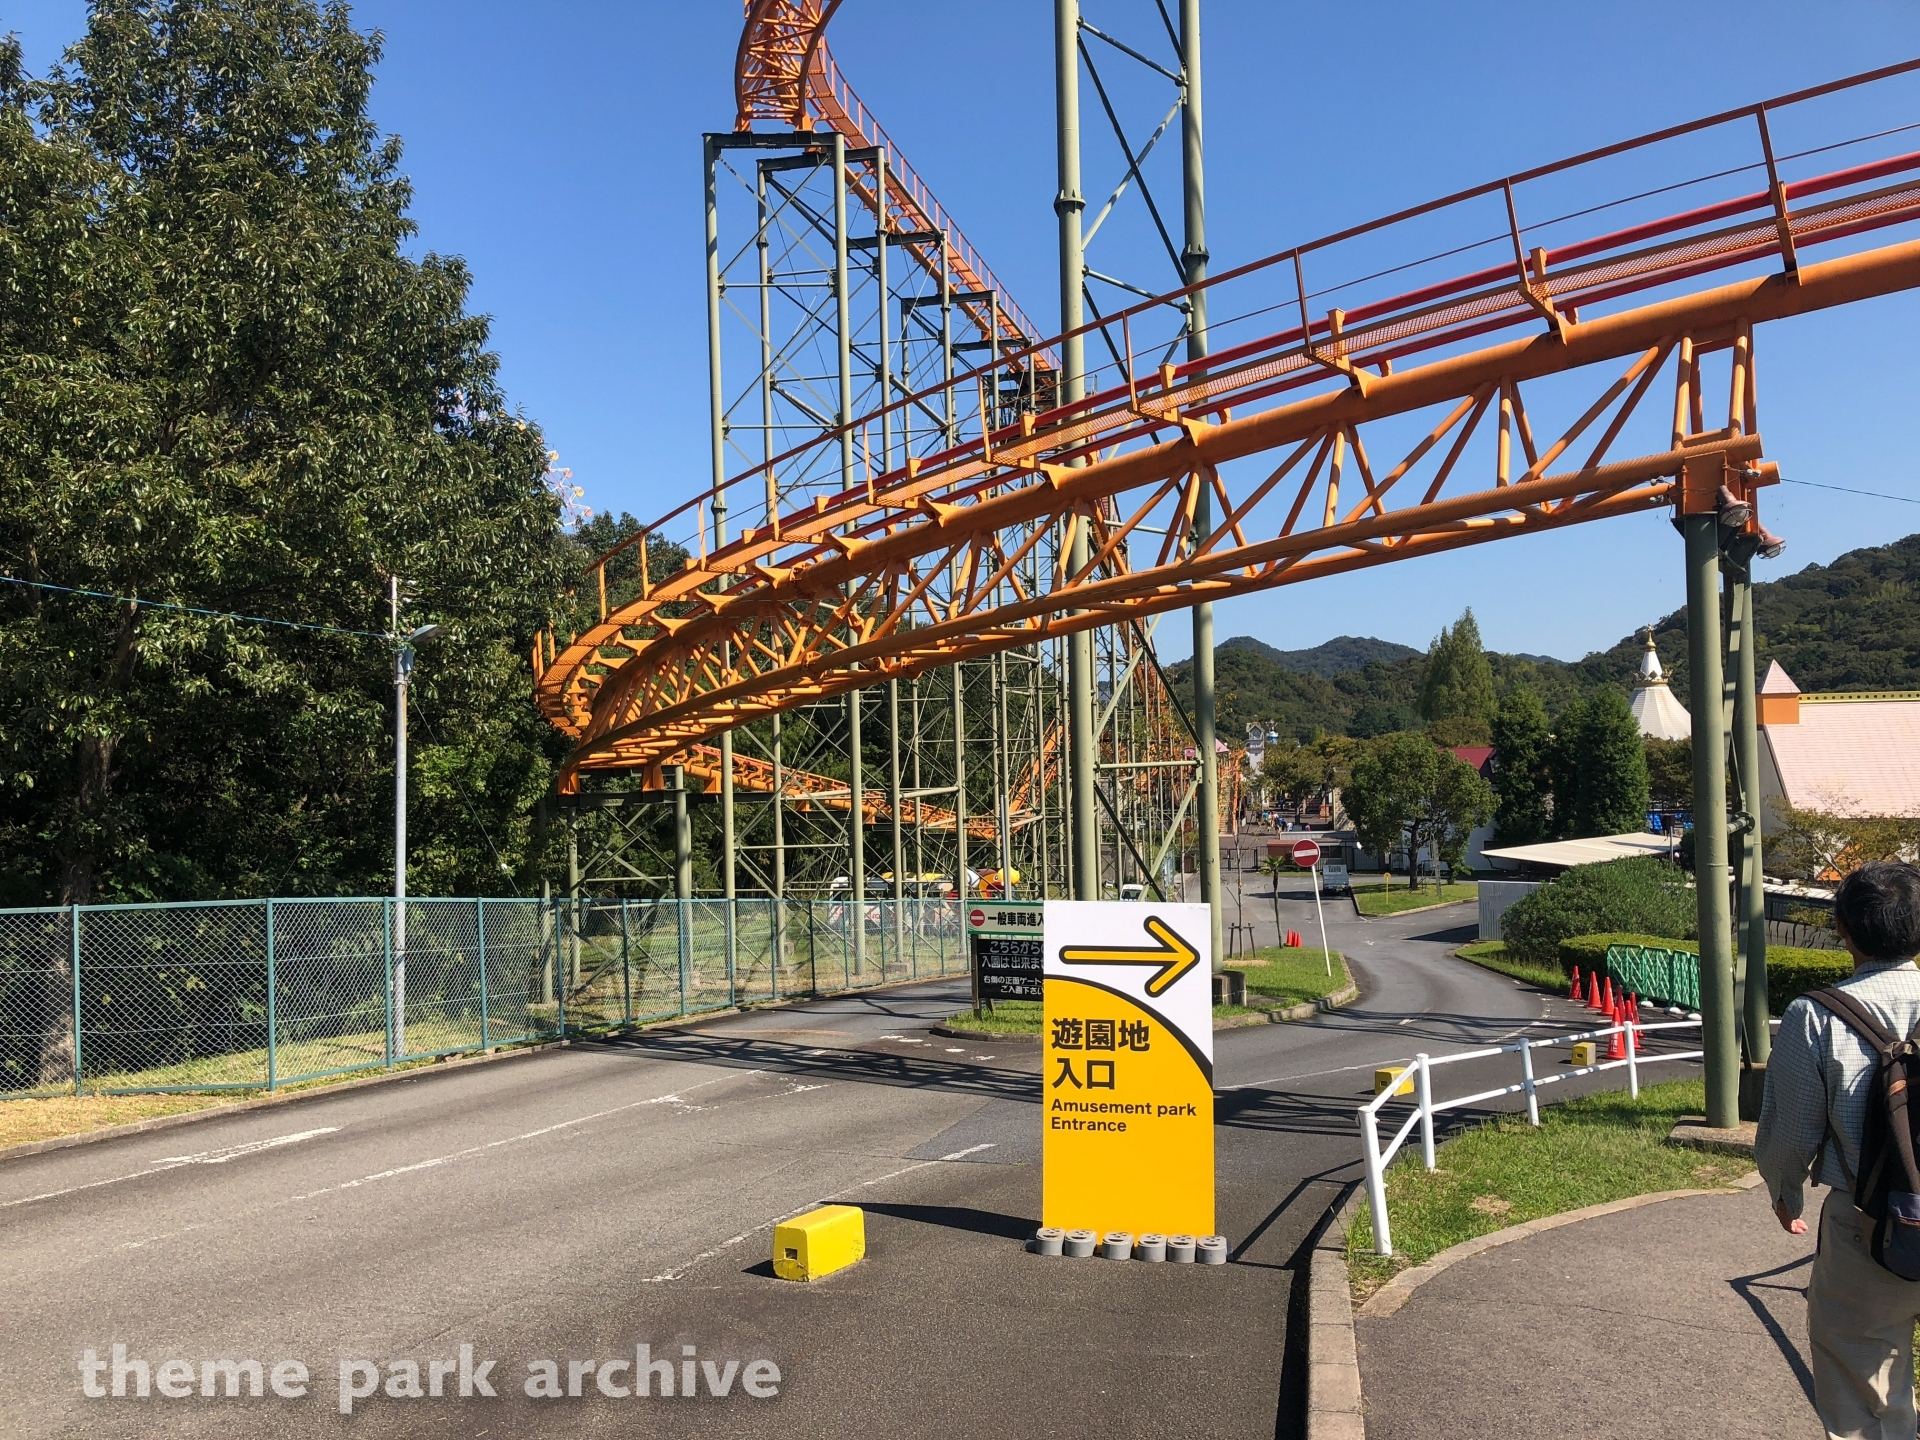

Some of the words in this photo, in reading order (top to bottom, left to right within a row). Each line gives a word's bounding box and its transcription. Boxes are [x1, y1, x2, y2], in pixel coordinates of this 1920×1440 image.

[989, 941, 1044, 954] こちらから
[983, 975, 1044, 986] 右側の正面ゲート
[1051, 1018, 1150, 1052] 遊園地
[1052, 1058, 1115, 1090] 入口
[1051, 1098, 1152, 1115] Amusement
[1157, 1103, 1197, 1118] park
[1051, 1116, 1127, 1132] Entrance
